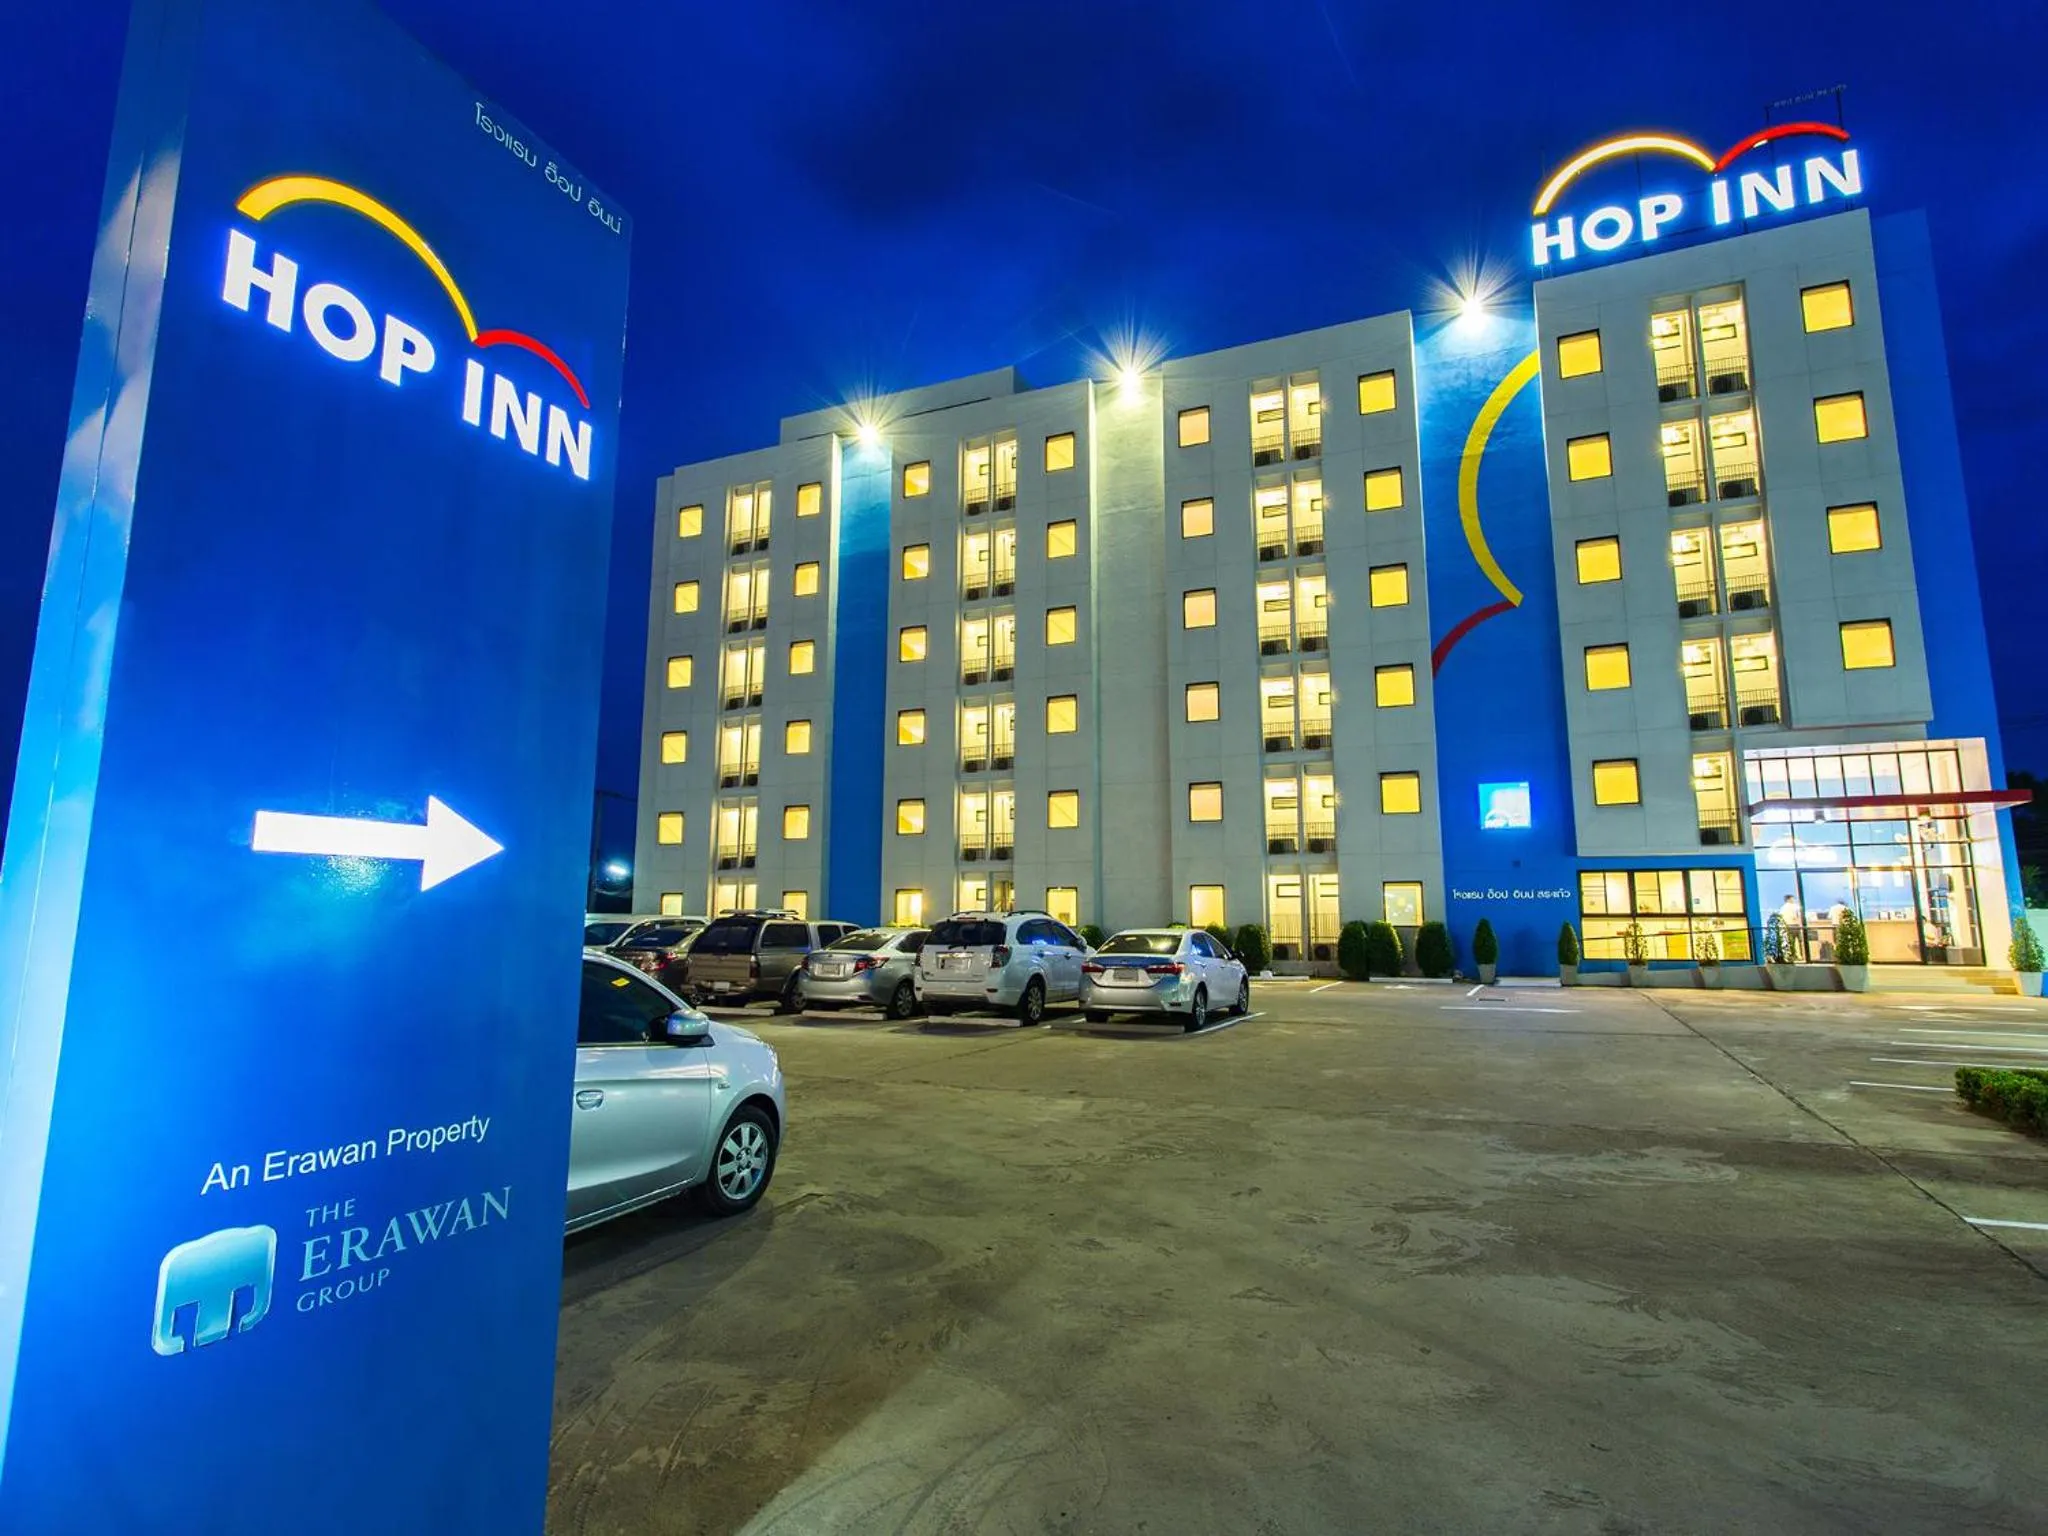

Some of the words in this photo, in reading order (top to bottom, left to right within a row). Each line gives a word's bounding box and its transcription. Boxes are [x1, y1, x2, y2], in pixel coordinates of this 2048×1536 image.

[475, 102, 537, 167] โรงแรม
[1531, 193, 1683, 267] HOP
[1711, 149, 1863, 226] INN
[222, 228, 436, 386] HOP
[462, 357, 593, 481] INN
[200, 1162, 250, 1196] An
[263, 1139, 377, 1182] Erawan
[387, 1115, 491, 1156] Property
[299, 1185, 513, 1282] ERAWAN
[306, 1197, 357, 1228] THE
[296, 1267, 390, 1313] GROUP
